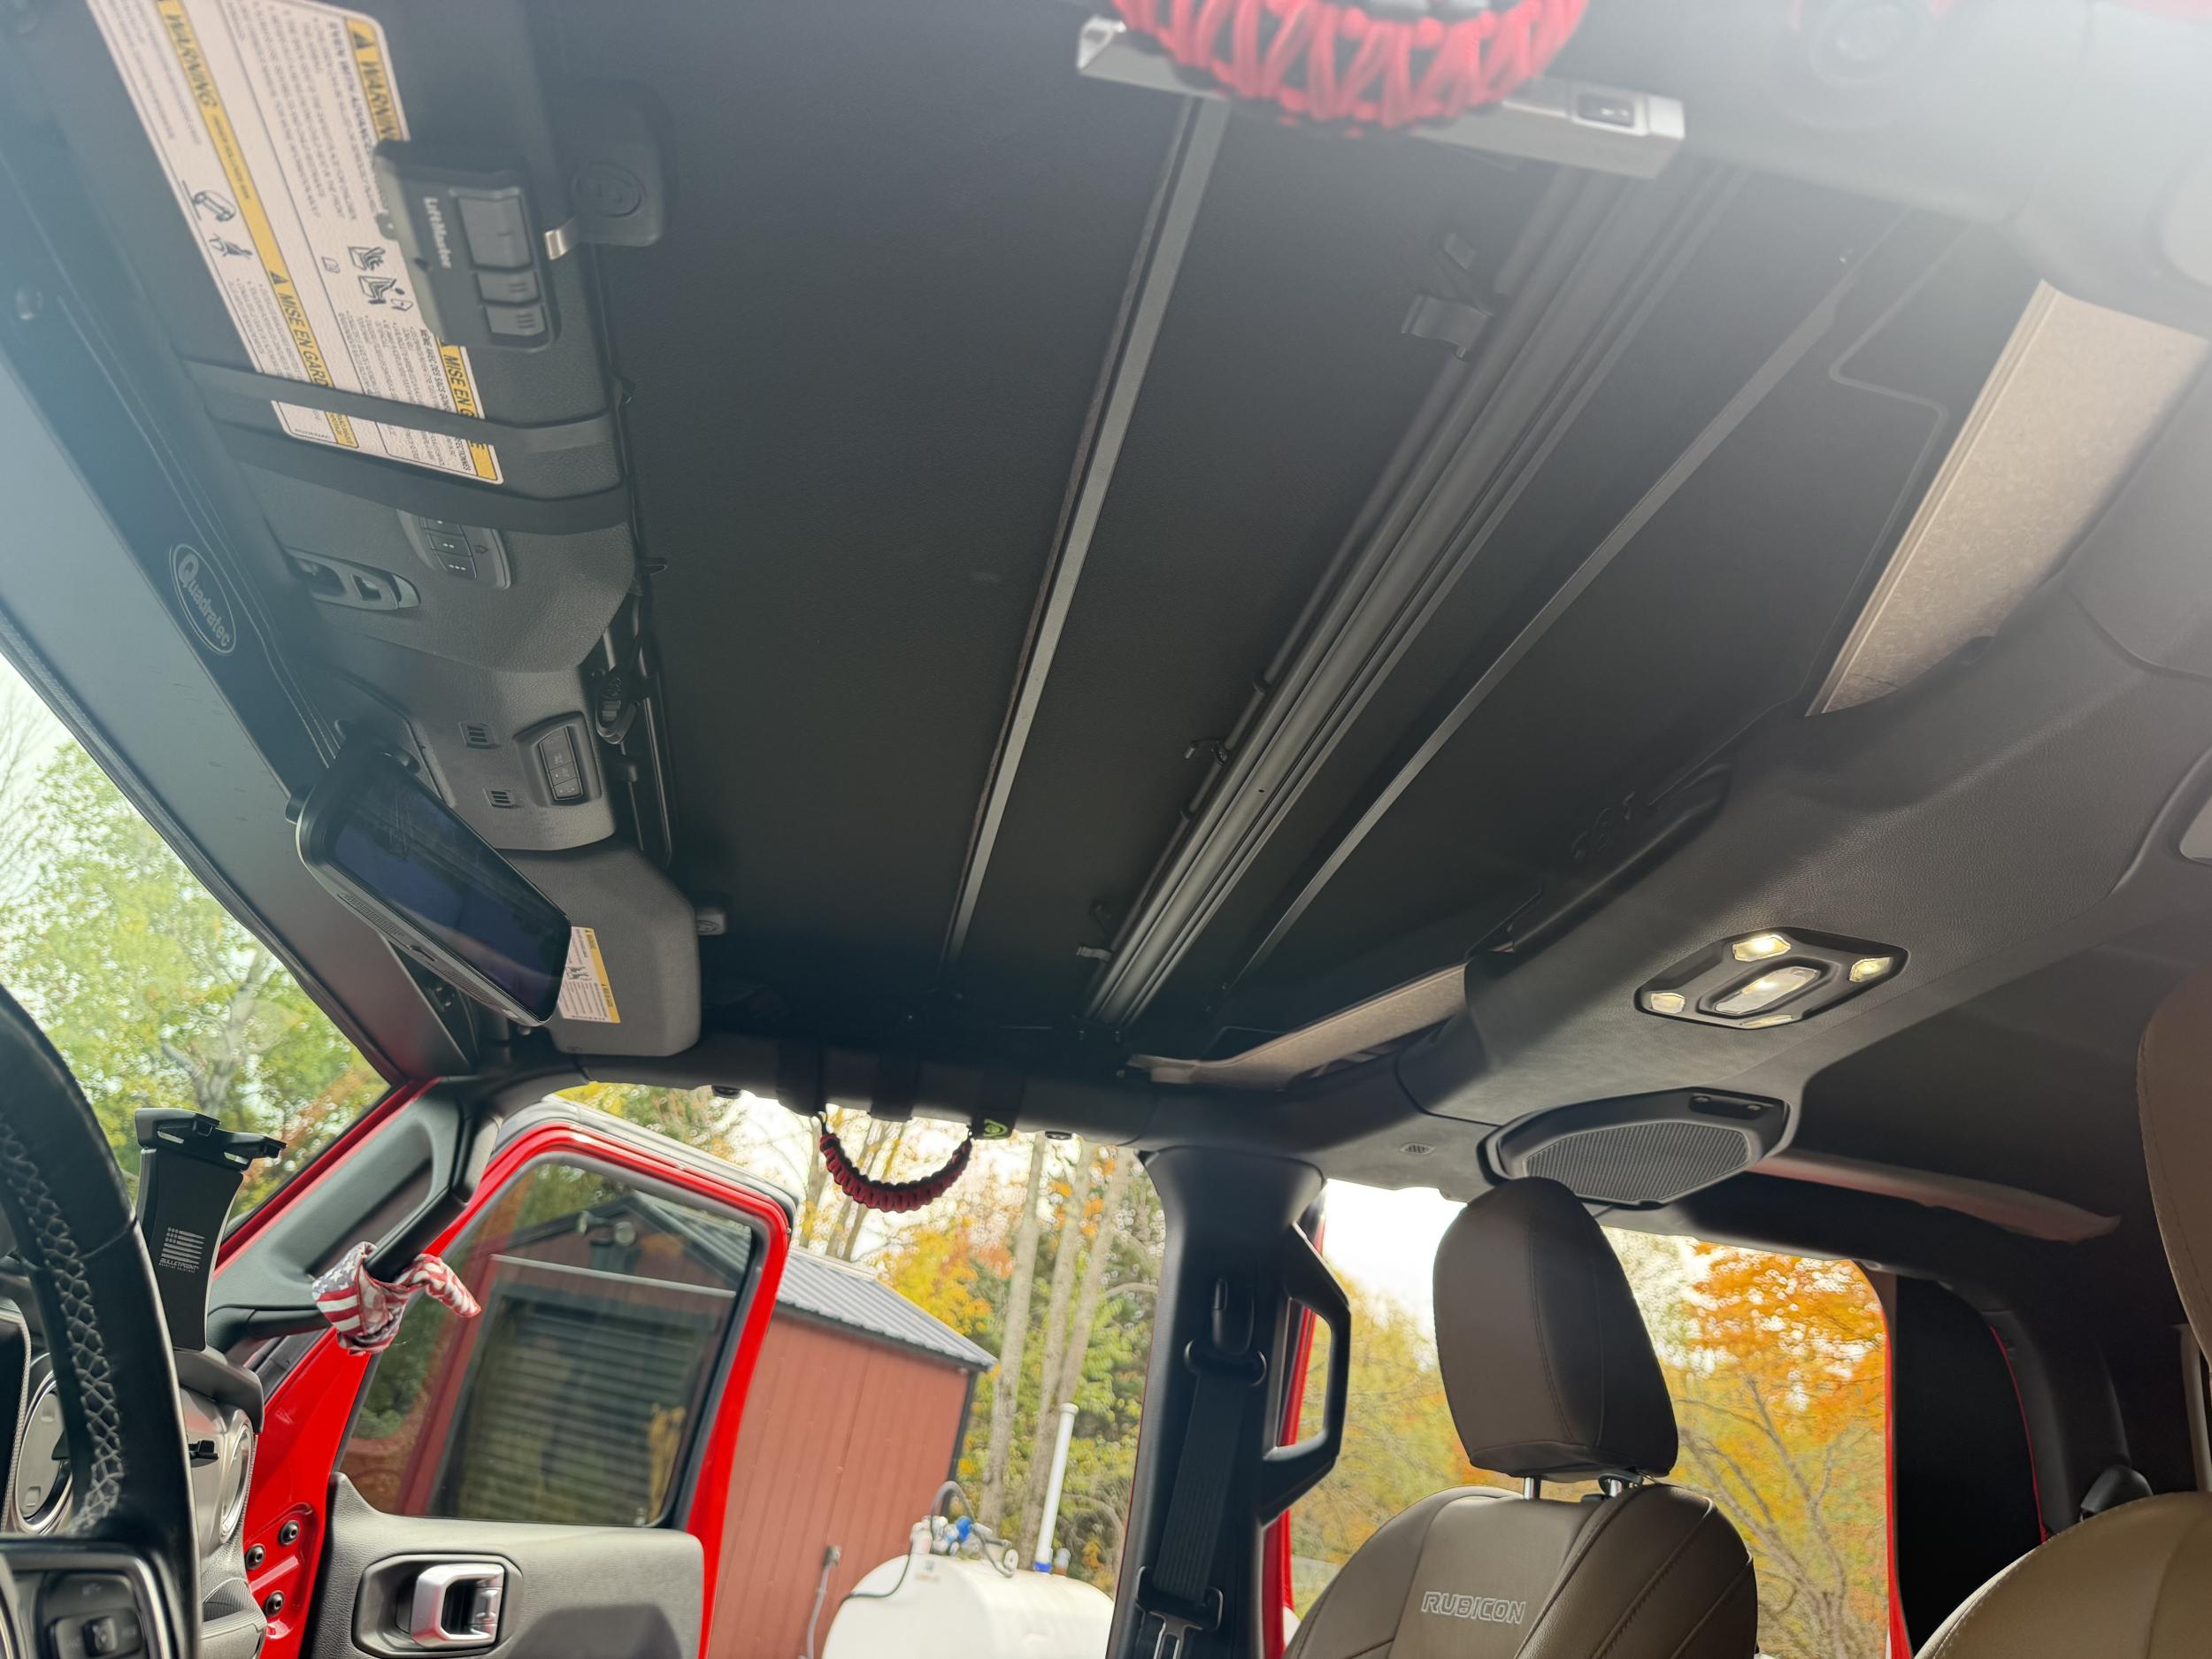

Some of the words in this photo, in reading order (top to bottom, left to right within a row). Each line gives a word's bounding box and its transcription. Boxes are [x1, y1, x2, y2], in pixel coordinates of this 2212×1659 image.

[165, 13, 218, 108] WARNING
[360, 62, 398, 139] WARNIN
[279, 294, 304, 326] MISE
[295, 328, 312, 348] EN
[303, 350, 328, 386] GARD
[443, 355, 465, 385] MISE
[455, 388, 471, 405] EN
[178, 553, 230, 647] Quadratec
[1421, 1591, 1526, 1624] RUBICON
